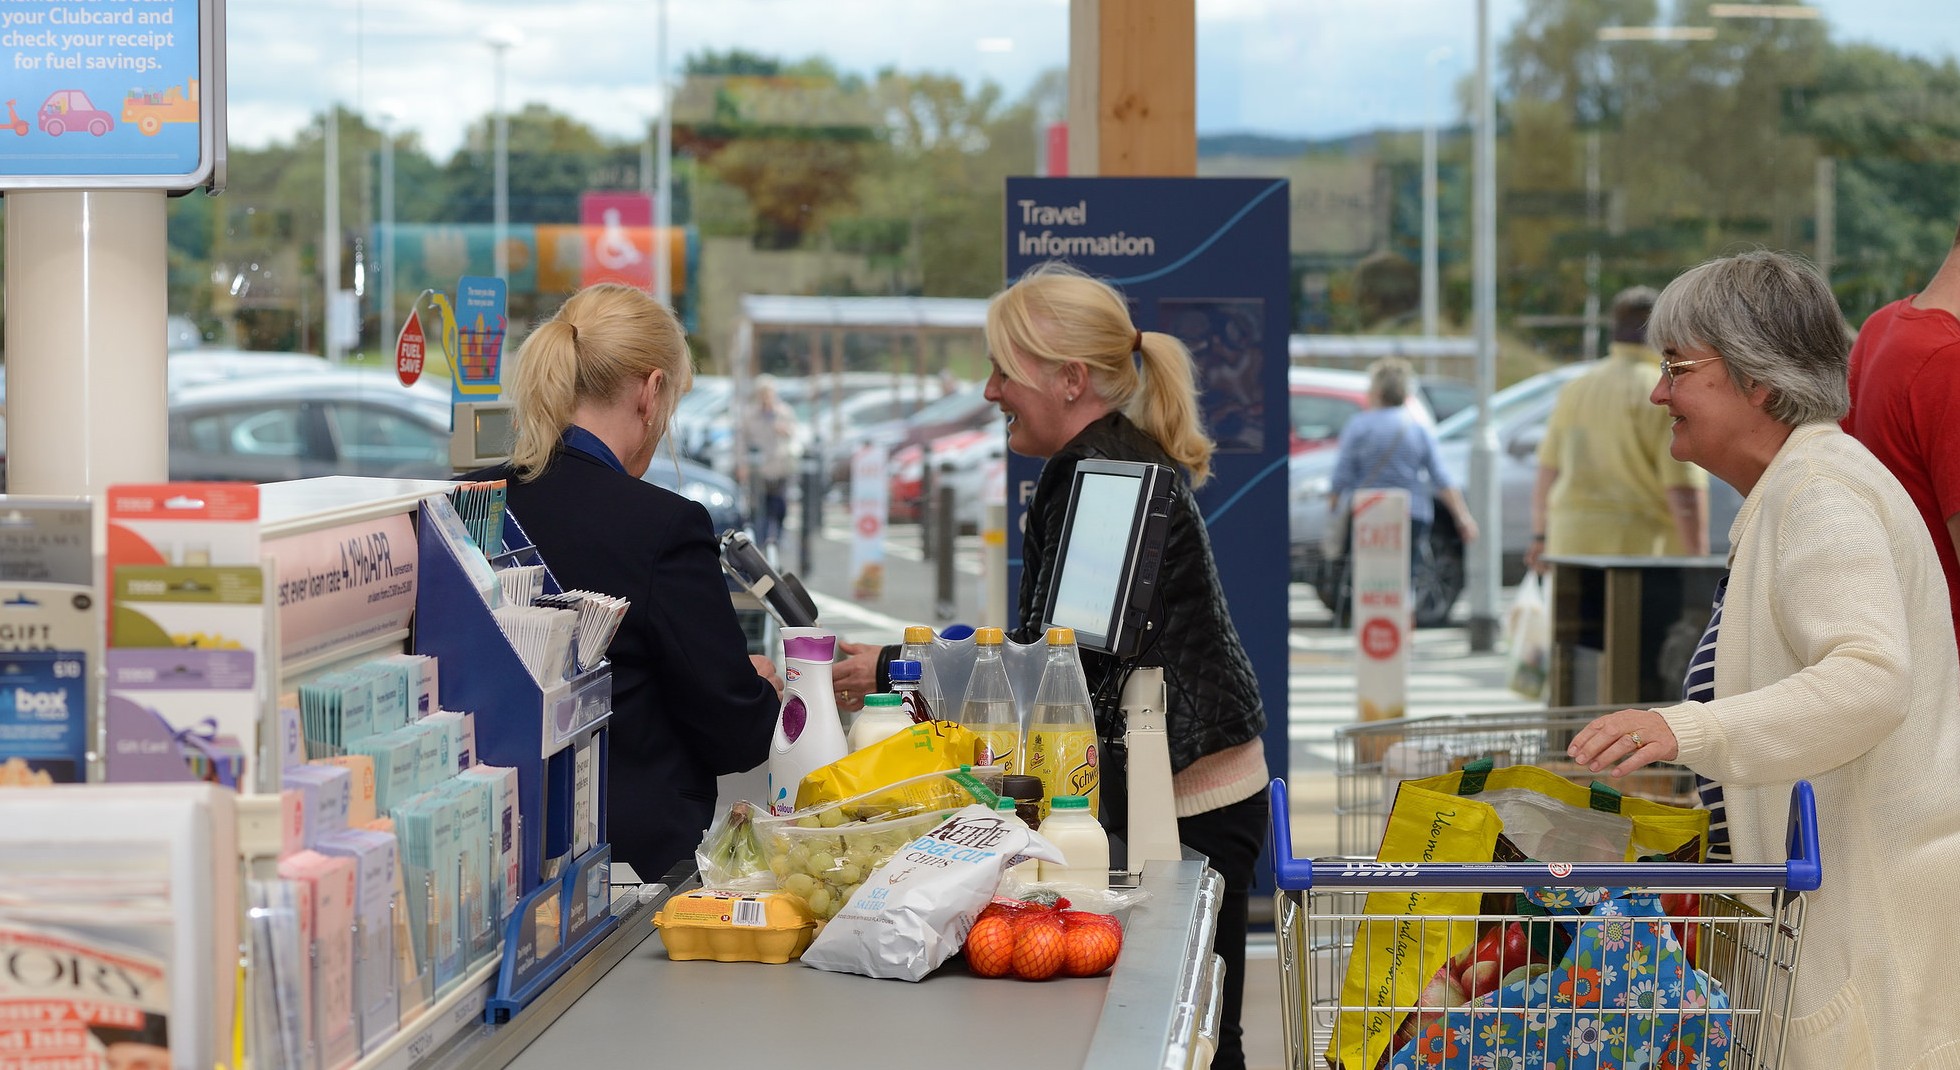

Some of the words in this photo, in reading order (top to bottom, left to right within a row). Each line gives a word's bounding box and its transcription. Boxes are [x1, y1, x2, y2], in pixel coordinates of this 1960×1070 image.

[2, 11, 46, 28] your
[50, 7, 134, 25] Clubcard
[138, 7, 174, 25] and
[2, 30, 58, 47] check
[61, 34, 105, 51] your
[108, 30, 175, 50] receipt
[14, 52, 42, 69] for
[45, 52, 82, 69] fuel
[86, 52, 162, 73] savings.
[1017, 200, 1087, 225] Travel
[1018, 231, 1155, 256] Information
[401, 343, 421, 358] FUEL
[400, 358, 421, 373] SAVE
[291, 577, 308, 604] ever
[308, 567, 325, 599] loan
[326, 566, 341, 594] rate
[0, 624, 50, 640] GIFT
[15, 687, 68, 712] box
[957, 774, 974, 788] Green
[776, 804, 794, 814] colour
[927, 817, 1010, 849] KETTLE
[1431, 811, 1456, 838] Use
[906, 852, 954, 868] CHIPS
[951, 849, 998, 864] CUT
[1423, 839, 1437, 862] me
[868, 887, 890, 899] SEA
[854, 900, 886, 911] SALTED
[7, 947, 142, 999] ORY
